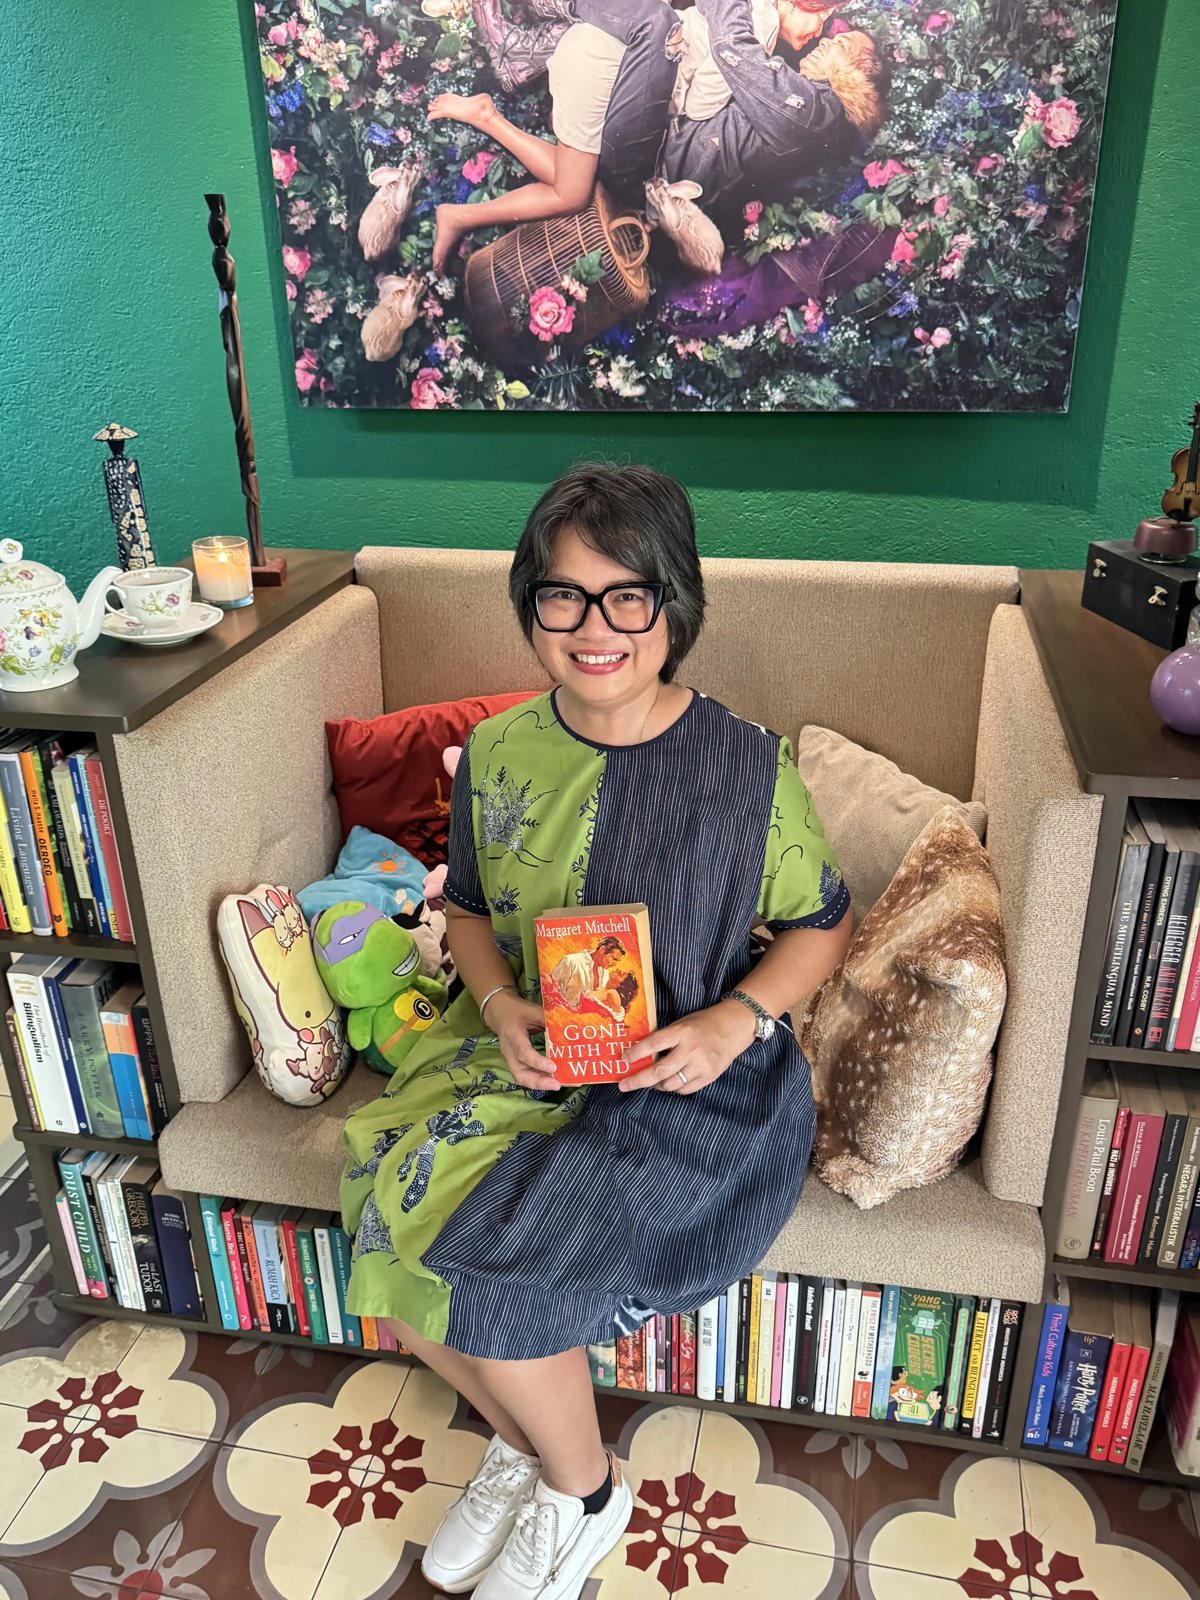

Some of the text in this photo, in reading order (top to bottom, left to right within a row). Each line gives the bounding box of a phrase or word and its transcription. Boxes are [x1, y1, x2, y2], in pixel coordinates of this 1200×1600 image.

[98, 800, 106, 809] DE
[35, 812, 44, 833] Haasse
[101, 811, 112, 836] POORT
[10, 807, 34, 895] Living Languages
[39, 838, 52, 876] OEROEG
[1146, 883, 1155, 898] BENS
[1156, 876, 1172, 926] DYING EMBERS
[1144, 900, 1152, 911] LEO
[536, 918, 631, 941] Margaret Mitchell
[1138, 923, 1147, 943] AKTUIL
[1099, 900, 1133, 1027] THE MULTILINGUAL MIND
[1151, 914, 1188, 1019] HEIDEGGER AND NAZISM
[1139, 975, 1152, 1012] M.R. COSBY
[1189, 976, 1200, 1002] LEGENDA
[23, 1002, 44, 1062] Bilingualism
[33, 1004, 51, 1059] The Handbook of
[142, 1018, 154, 1045] BPPN
[563, 1023, 627, 1041] GONE
[550, 1043, 600, 1060] WITH
[88, 1059, 103, 1098] POTTER
[568, 1061, 630, 1077] WIND
[1066, 1117, 1096, 1219] DE KAPELLEKENSBAAN
[1085, 1118, 1111, 1193] Louis Paul Boon
[1109, 1150, 1120, 1162] NAZI
[1103, 1168, 1115, 1196] INDONESIA
[63, 1170, 91, 1253] DUST CHILD
[125, 1188, 141, 1228] GREGORY
[134, 1192, 149, 1226] PHILIPPA
[1166, 1164, 1192, 1247] NEGARA INTEGRALISTIK
[206, 1217, 217, 1238] Bilingual
[223, 1220, 235, 1255] Martin Bril
[1123, 1194, 1142, 1259] Professional Development Manual
[1149, 1215, 1160, 1239] Reformasi
[301, 1239, 312, 1274] BURMESE DAYS
[1145, 1240, 1155, 1257] Hukum
[1187, 1239, 1197, 1261] OXFORD
[140, 1262, 153, 1293] TUDOR
[151, 1272, 163, 1294] LAST
[243, 1262, 251, 1283] Nagasaki
[265, 1260, 278, 1284] RUMAH
[270, 1284, 281, 1301] KACA
[913, 1294, 941, 1304] YANG
[804, 1286, 815, 1331] Abdelkader Benali
[869, 1309, 877, 1324] PRICE
[973, 1317, 985, 1352] LITERACY
[1050, 1313, 1063, 1332] Third
[865, 1332, 875, 1367] MOTHERHOOD
[1003, 1327, 1011, 1346] INDUSTRI
[1045, 1333, 1059, 1360] Culture
[681, 1343, 694, 1358] Sing
[907, 1332, 920, 1375] CODERS
[921, 1335, 935, 1377] SECRET
[997, 1360, 1006, 1382] INDONESIA
[1041, 1361, 1054, 1377] Kids
[1075, 1363, 1097, 1388] Harry
[965, 1366, 979, 1411] BILINGUALISM
[1037, 1384, 1046, 1398] Pollock
[1071, 1386, 1097, 1413] Potter
[1128, 1379, 1139, 1397] ENGELS
[1133, 1352, 1164, 1450] MULTATULI MAX HAVELAAR
[1102, 1376, 1118, 1428] NEDERLANDS ENGELS
[1121, 1400, 1134, 1429] NEDERLANDS
